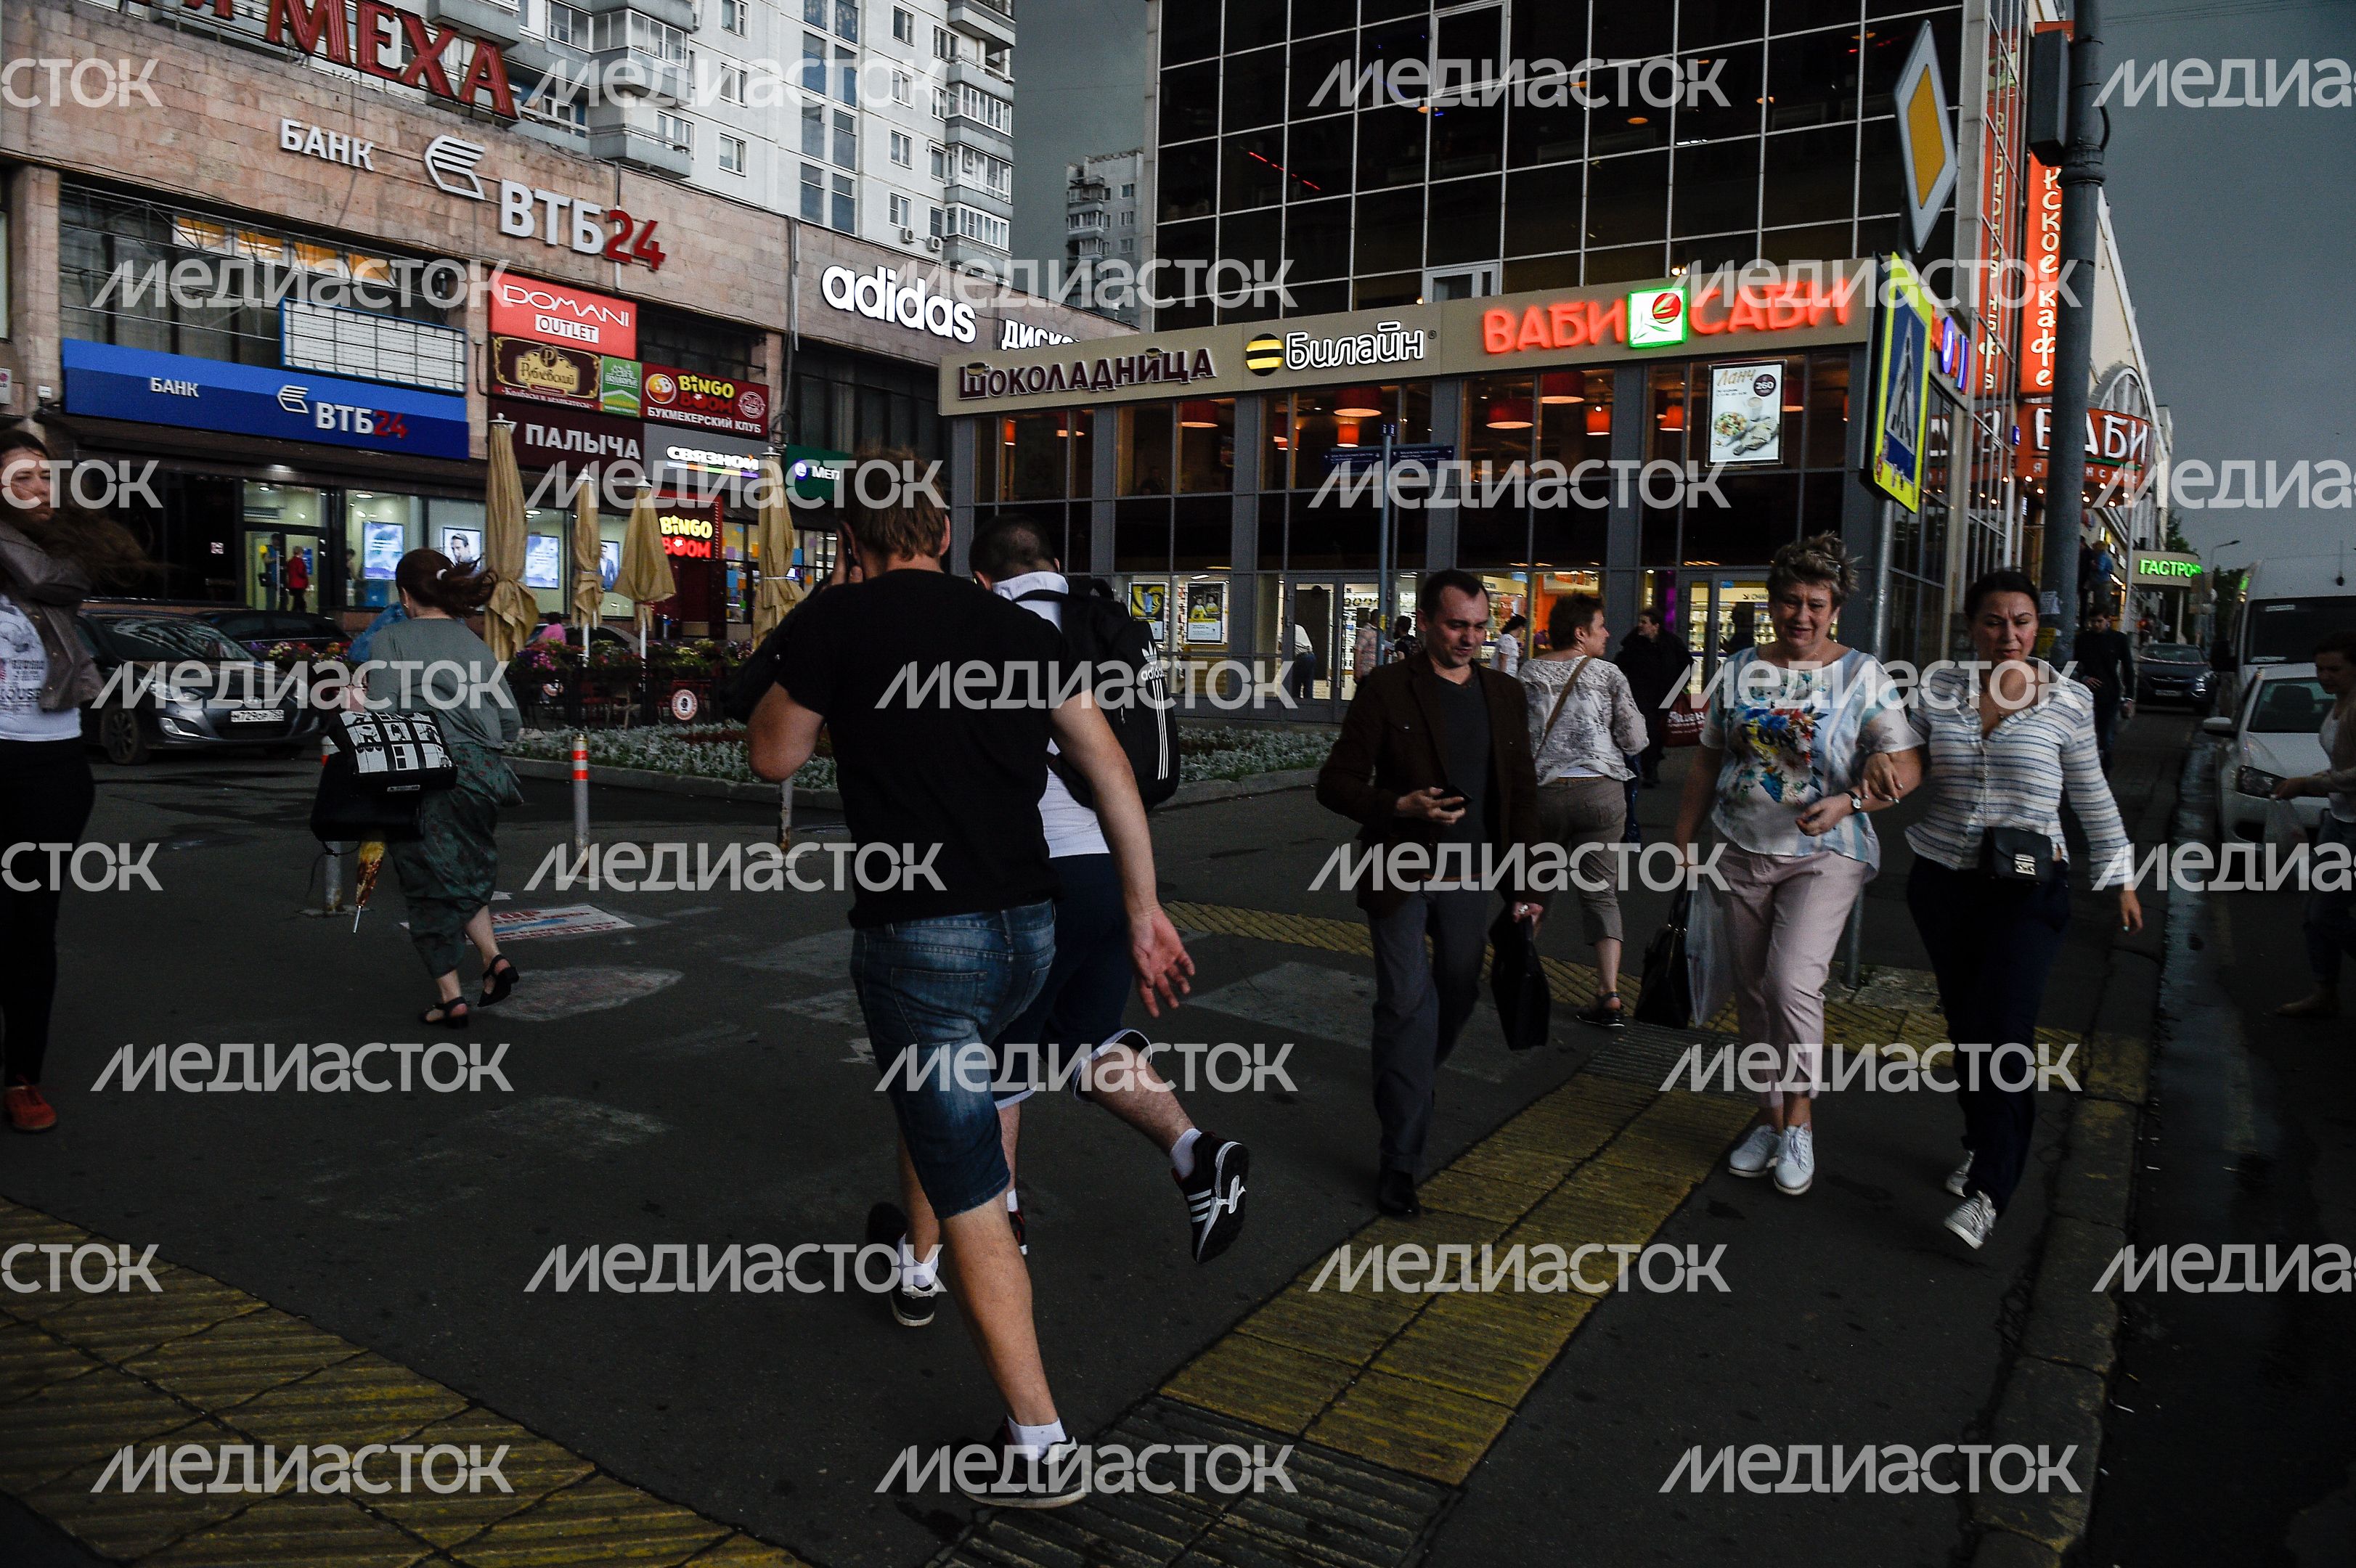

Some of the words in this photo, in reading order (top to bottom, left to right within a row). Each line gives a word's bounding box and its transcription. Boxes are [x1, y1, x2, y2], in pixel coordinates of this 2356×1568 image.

[266, 0, 520, 121] МЕХА
[281, 118, 375, 171] БАНК
[500, 179, 667, 271] ВТБ24
[503, 285, 629, 327] DOMANI
[821, 264, 978, 343] adidas
[1483, 298, 1626, 355] ВАБИ
[1688, 277, 1853, 337] САБИ
[539, 317, 595, 340] OUTLET
[1285, 321, 1425, 371] Билайн
[150, 377, 200, 399] БАНК
[315, 401, 408, 439] ВТБ24
[525, 422, 641, 460] ПАЛЫЧА
[647, 406, 733, 429] БУКМЕКЕРСКИЙ
[735, 420, 762, 433] КЛУБ
